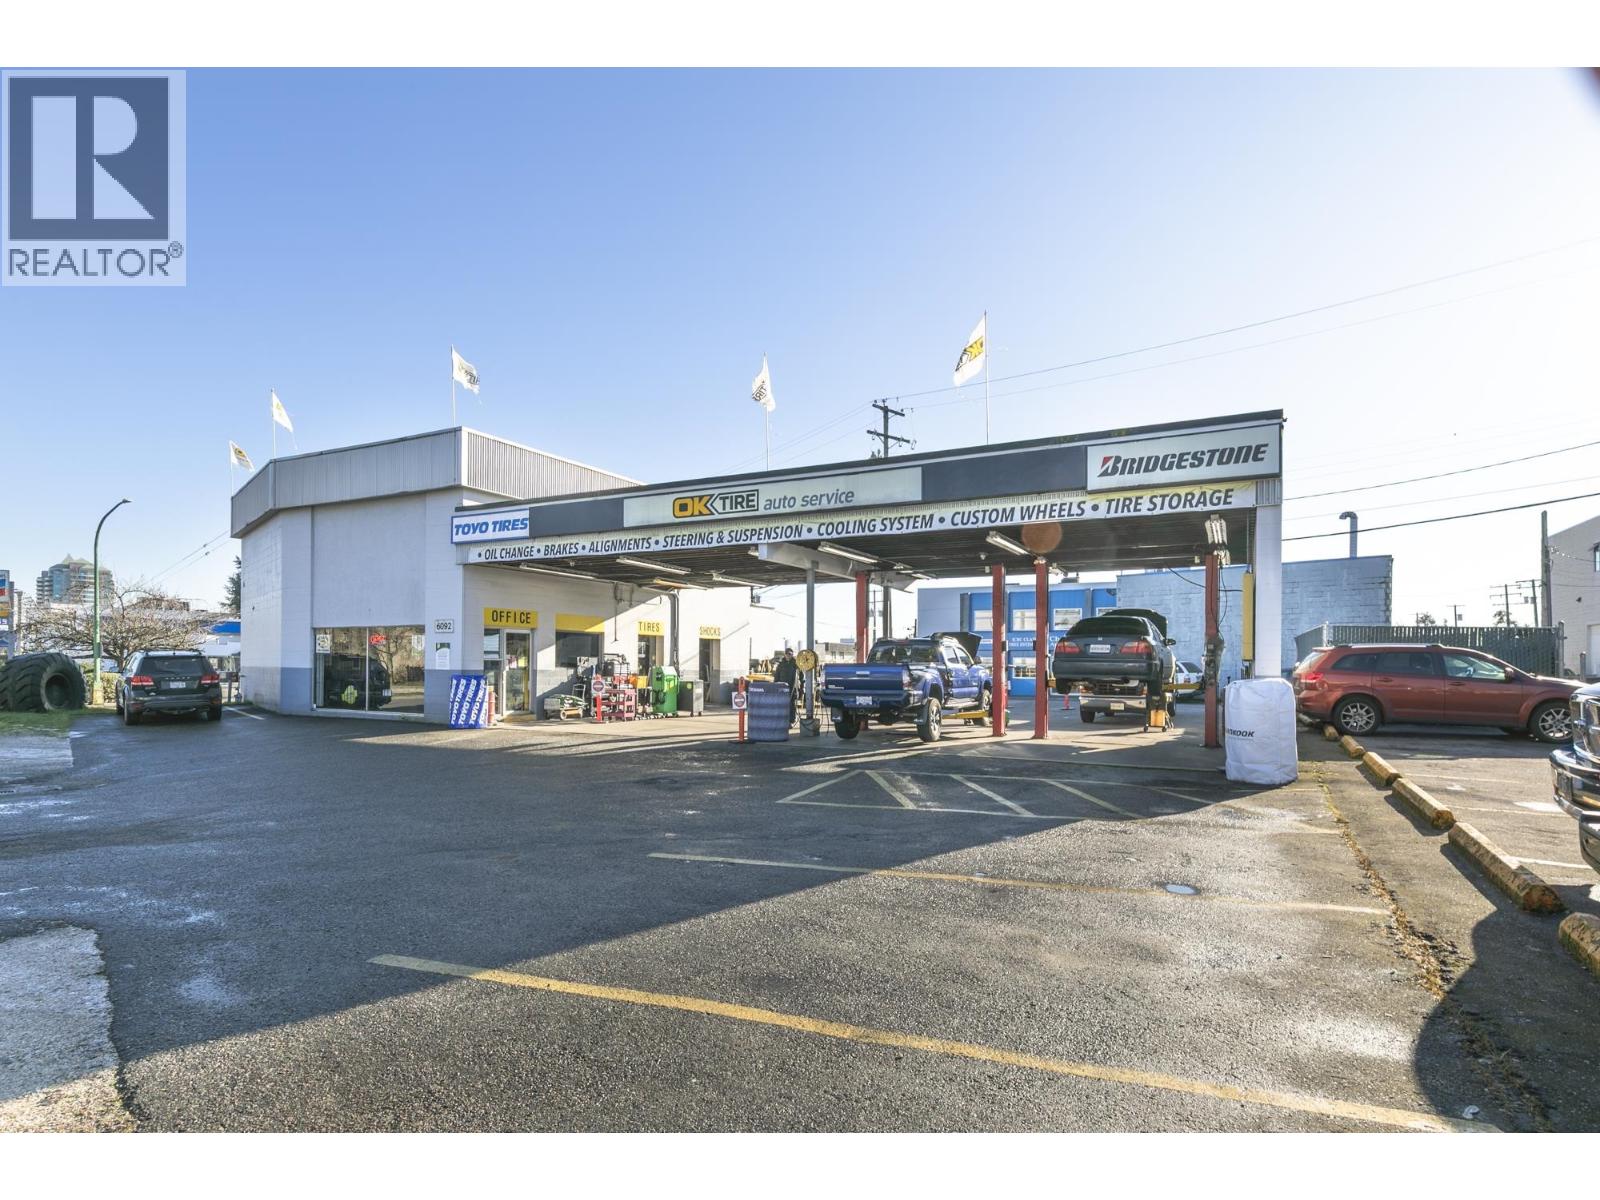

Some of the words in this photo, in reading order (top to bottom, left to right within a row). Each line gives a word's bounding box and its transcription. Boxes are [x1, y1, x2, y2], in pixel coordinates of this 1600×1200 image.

[1097, 443, 1269, 478] BRIDGESTONE
[672, 495, 714, 519] OK
[718, 492, 757, 511] TIRE
[763, 495, 797, 511] auto
[801, 489, 855, 508] service
[454, 521, 489, 536] TOYO
[492, 517, 529, 533] TIRES
[484, 548, 498, 560] OIL
[500, 545, 534, 559] CHANGE
[543, 542, 579, 556] BRAKES
[588, 536, 652, 553] ALIGNMENTS
[662, 531, 714, 548] STEERING
[716, 532, 725, 544] &
[727, 524, 803, 543] SUSPENSION
[817, 518, 877, 536] COOLING
[879, 513, 935, 532] SYSTEM
[950, 505, 1016, 527] CUSTOM
[1020, 500, 1086, 521] WHEELS
[1105, 496, 1143, 515] TIRE
[1147, 488, 1234, 512] STORAGE
[491, 610, 531, 624] OFFICE
[436, 622, 452, 630] 6092
[638, 621, 660, 633] TIRES
[699, 626, 721, 636] SHOCKS
